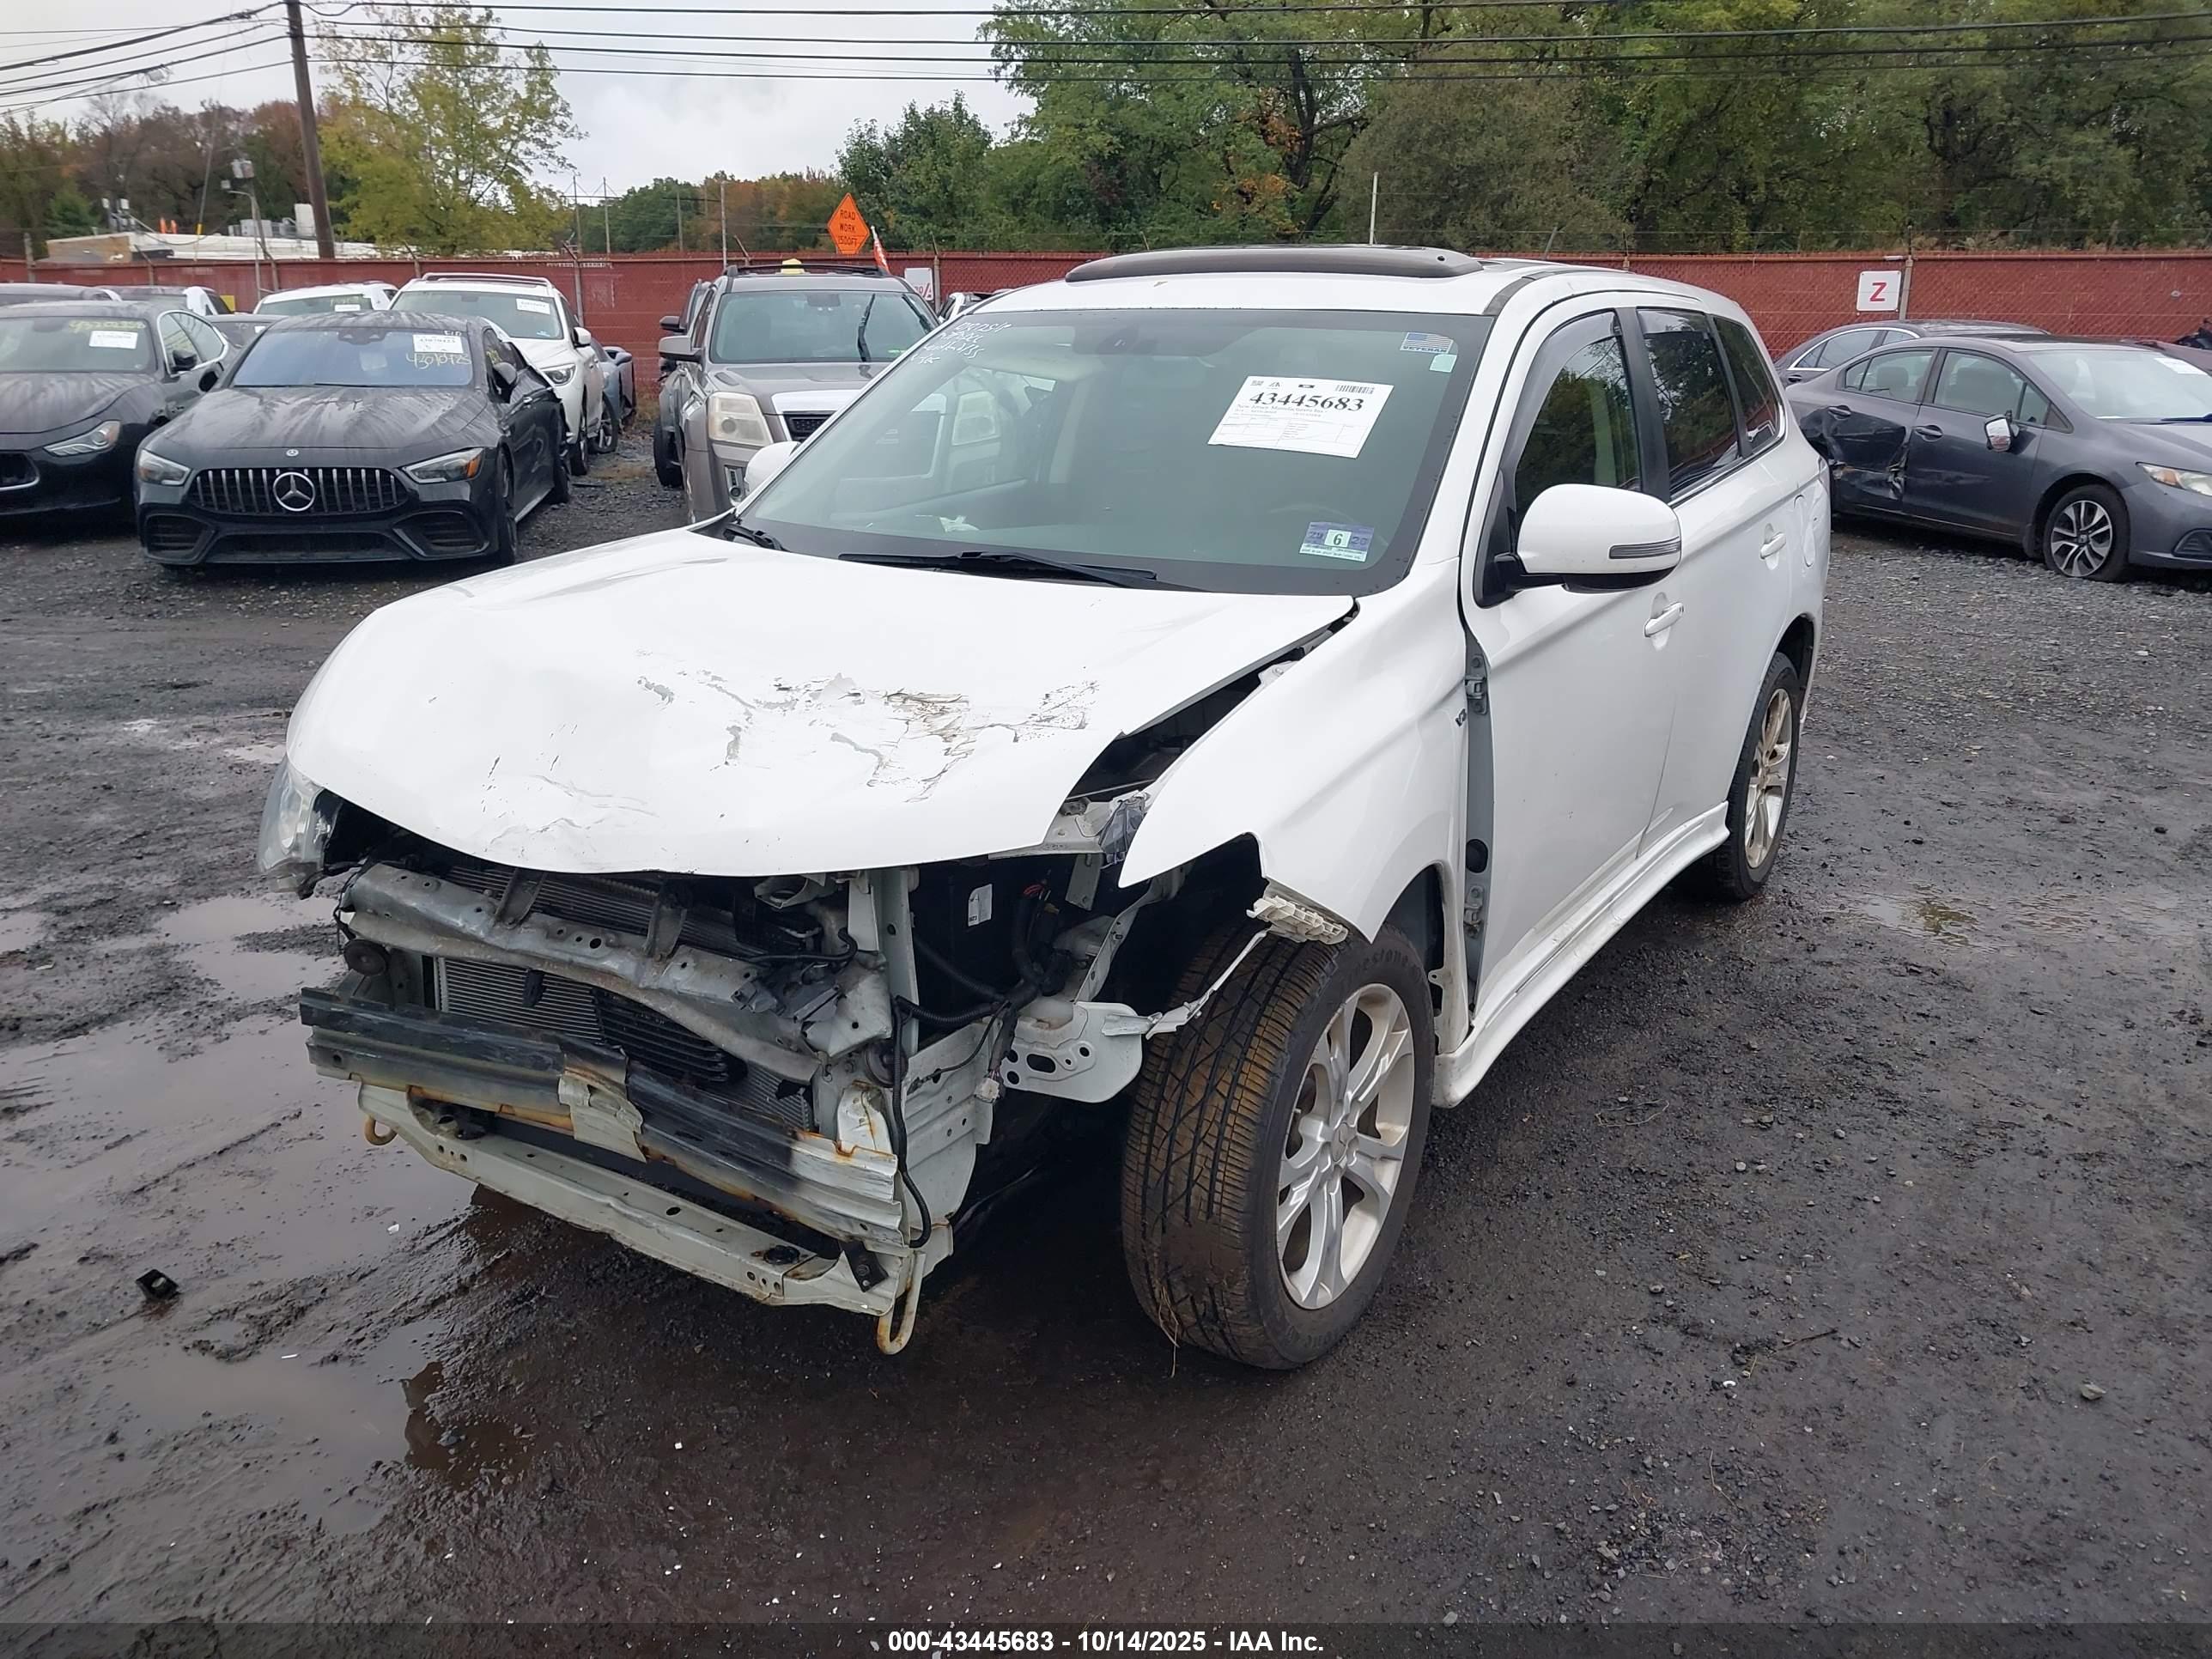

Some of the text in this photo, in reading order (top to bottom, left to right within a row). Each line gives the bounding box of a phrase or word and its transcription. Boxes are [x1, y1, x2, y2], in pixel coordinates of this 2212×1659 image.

[840, 210, 856, 221] ROAD
[840, 223, 856, 234] WORK
[1869, 282, 1887, 302] Z
[1249, 392, 1364, 412] 43445683
[1333, 533, 1344, 546] 6
